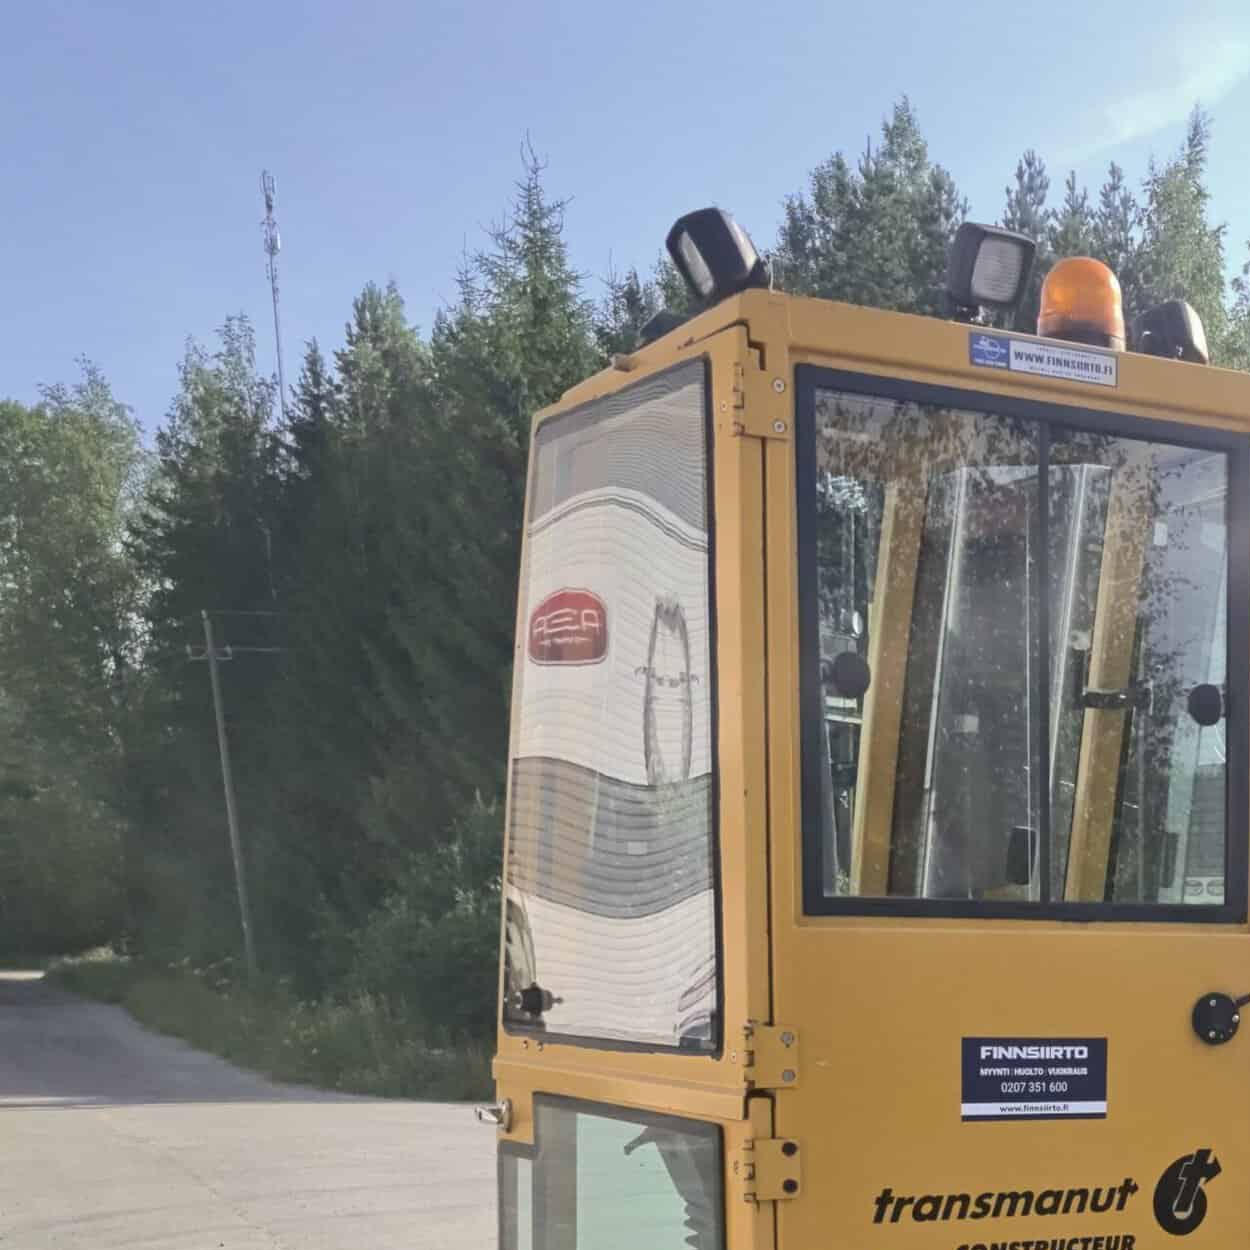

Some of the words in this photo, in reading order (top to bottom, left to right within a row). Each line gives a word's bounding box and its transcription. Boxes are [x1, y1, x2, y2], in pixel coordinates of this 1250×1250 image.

[980, 1046, 1088, 1059] FINNSIIRTO
[1001, 1082, 1026, 1093] 0207
[1029, 1082, 1046, 1093] 351
[1049, 1081, 1068, 1092] 600
[1000, 1103, 1069, 1113] www.finnsiirto.fi
[872, 1178, 1139, 1224] transmanut
